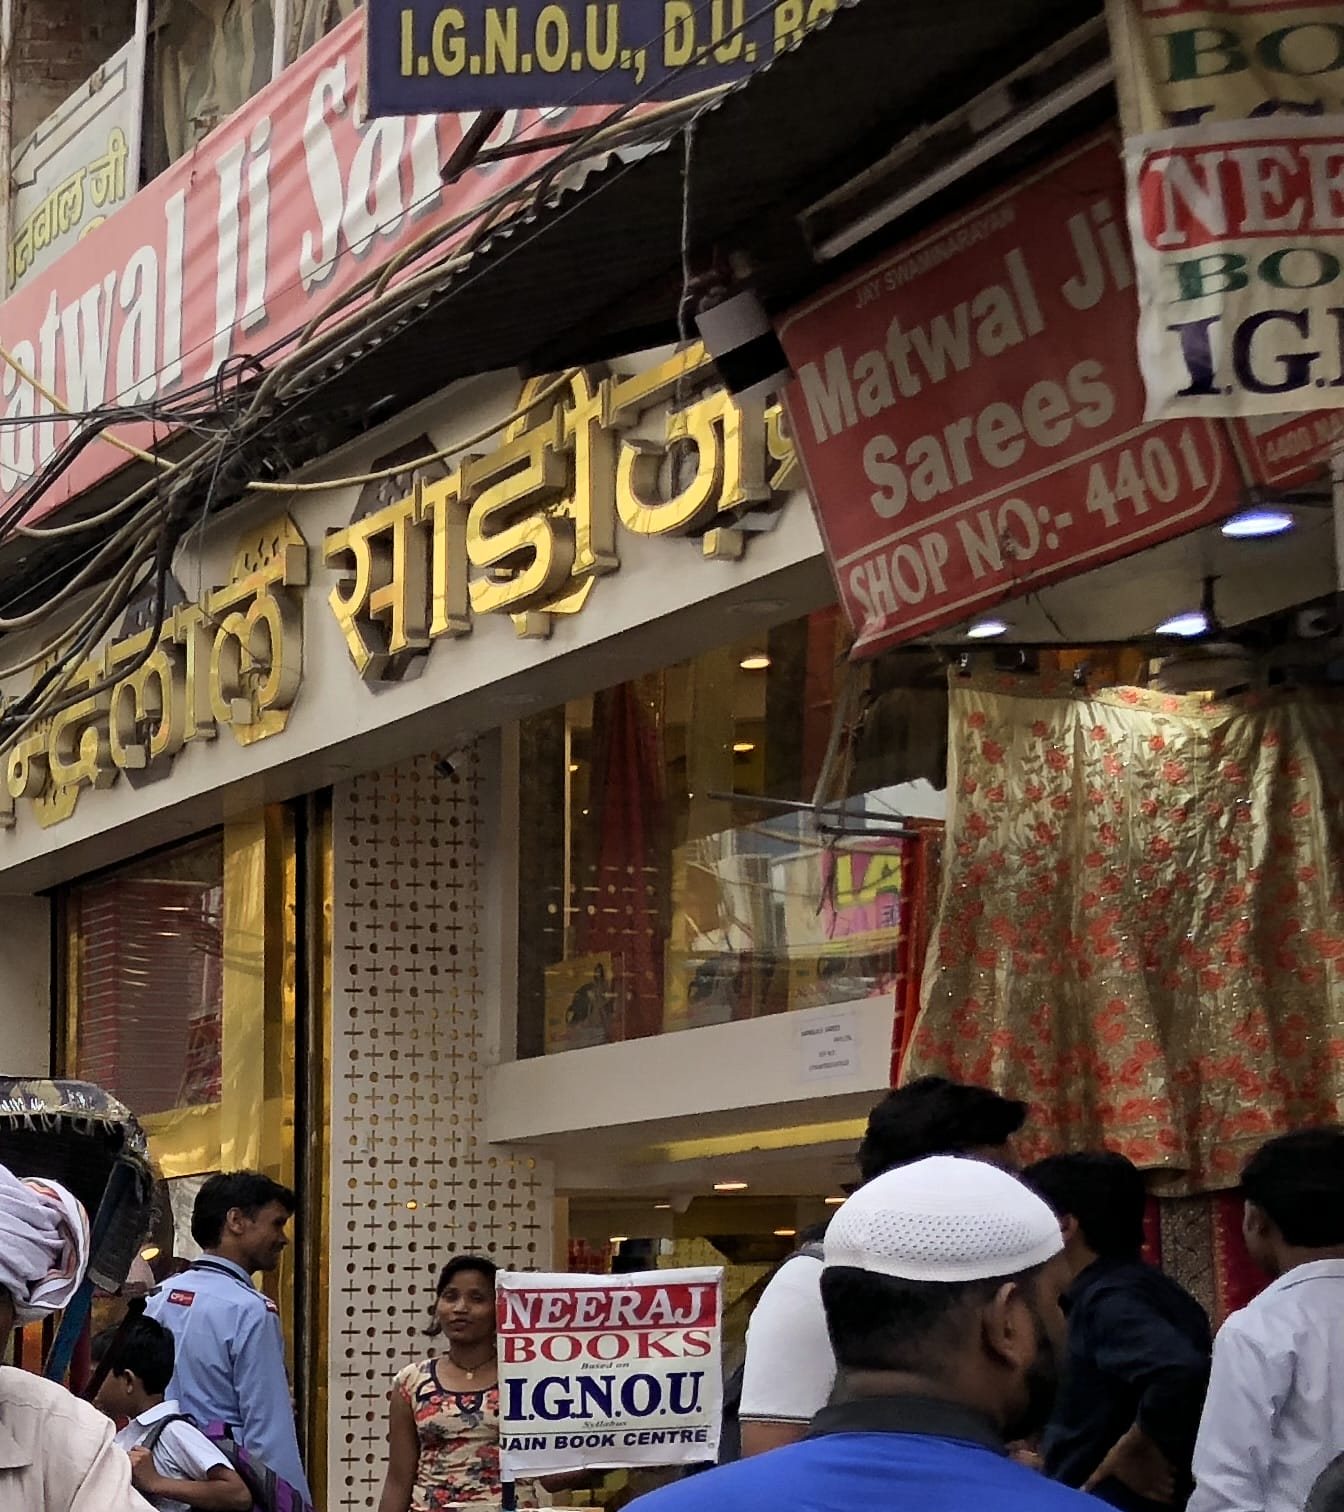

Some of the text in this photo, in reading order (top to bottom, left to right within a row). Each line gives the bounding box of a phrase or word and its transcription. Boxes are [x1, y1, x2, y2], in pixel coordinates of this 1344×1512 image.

[201, 116, 272, 382] Ji
[798, 248, 1045, 444] Matwal
[1060, 203, 1133, 311] Ji
[863, 359, 1116, 520] Sarees
[848, 529, 950, 628] SHOP
[1086, 427, 1209, 528] 4401
[501, 1286, 708, 1330] NEERAJ
[501, 1330, 712, 1364] BOOKS
[499, 1429, 709, 1451] JAIN BOOK CENTRE
[503, 1371, 705, 1421] I.G.N.O.U.
